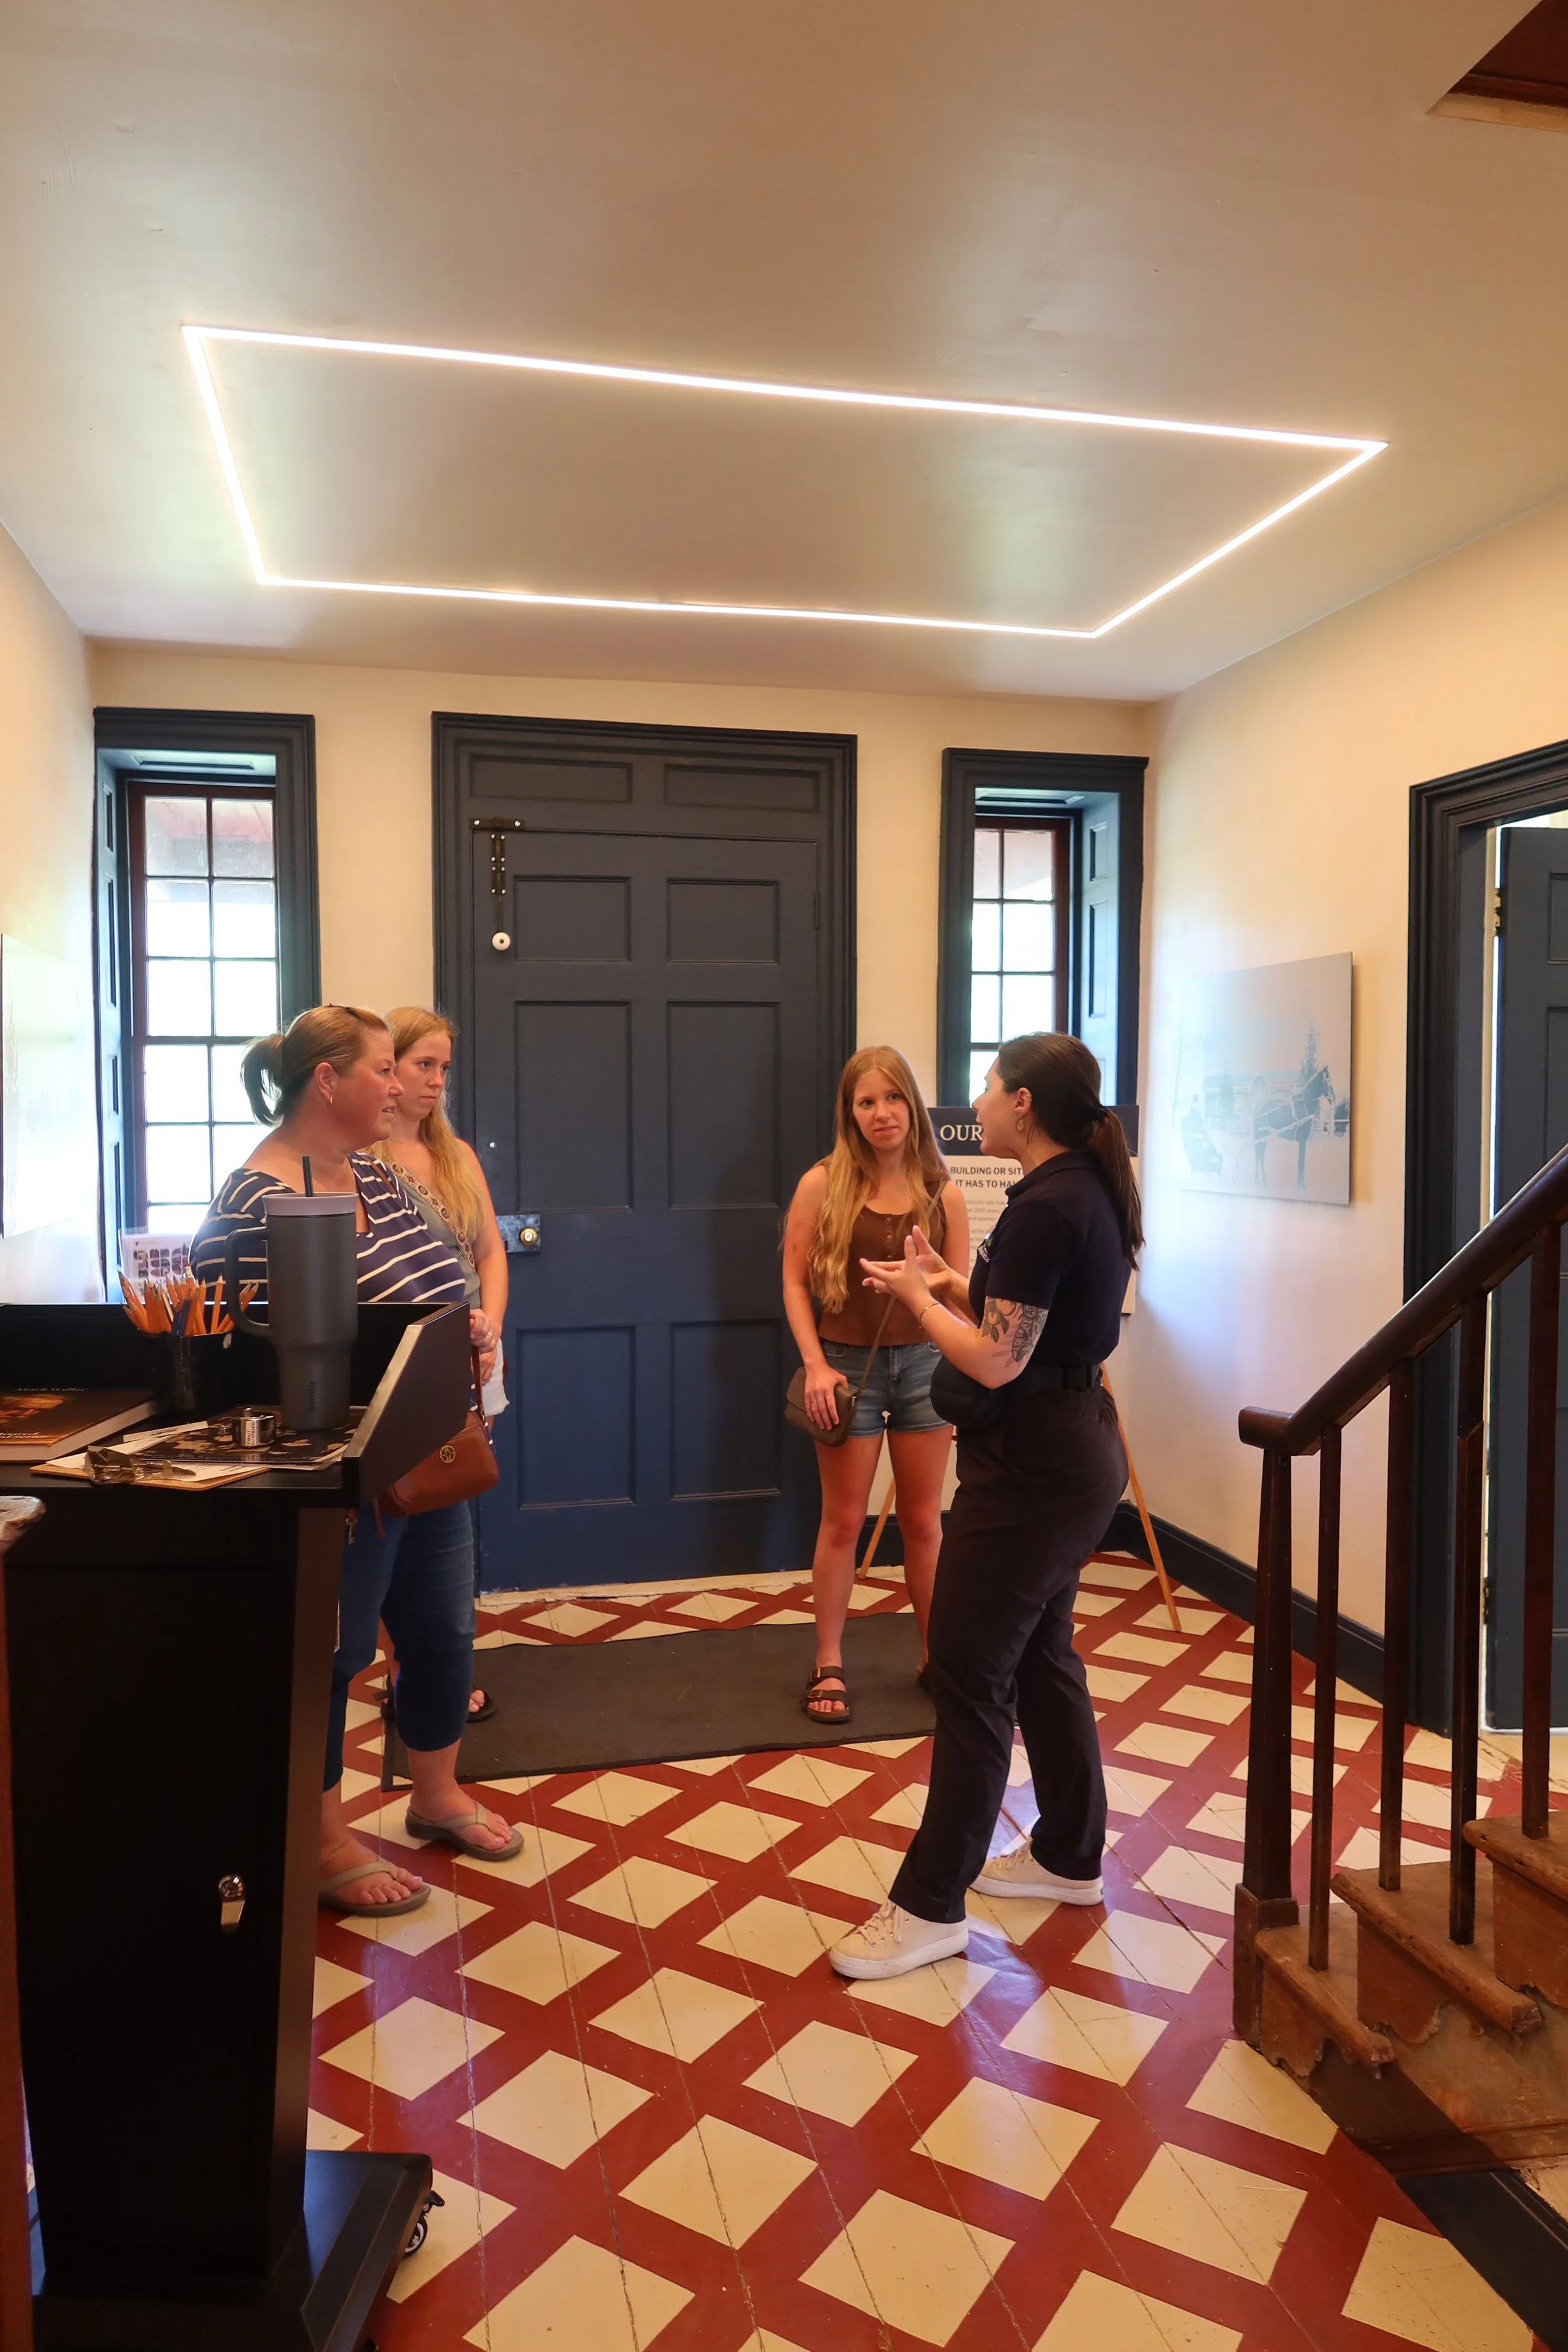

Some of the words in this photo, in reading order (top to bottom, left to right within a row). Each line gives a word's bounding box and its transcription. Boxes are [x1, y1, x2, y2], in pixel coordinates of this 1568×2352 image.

[940, 1125, 982, 1142] OUR
[950, 1167, 992, 1175] BUILDING
[993, 1167, 1006, 1175] OR
[966, 1180, 983, 1188] HAS
[986, 1180, 998, 1188] TO
[1000, 1180, 1015, 1189] HA
[307, 1382, 316, 1412] owala
